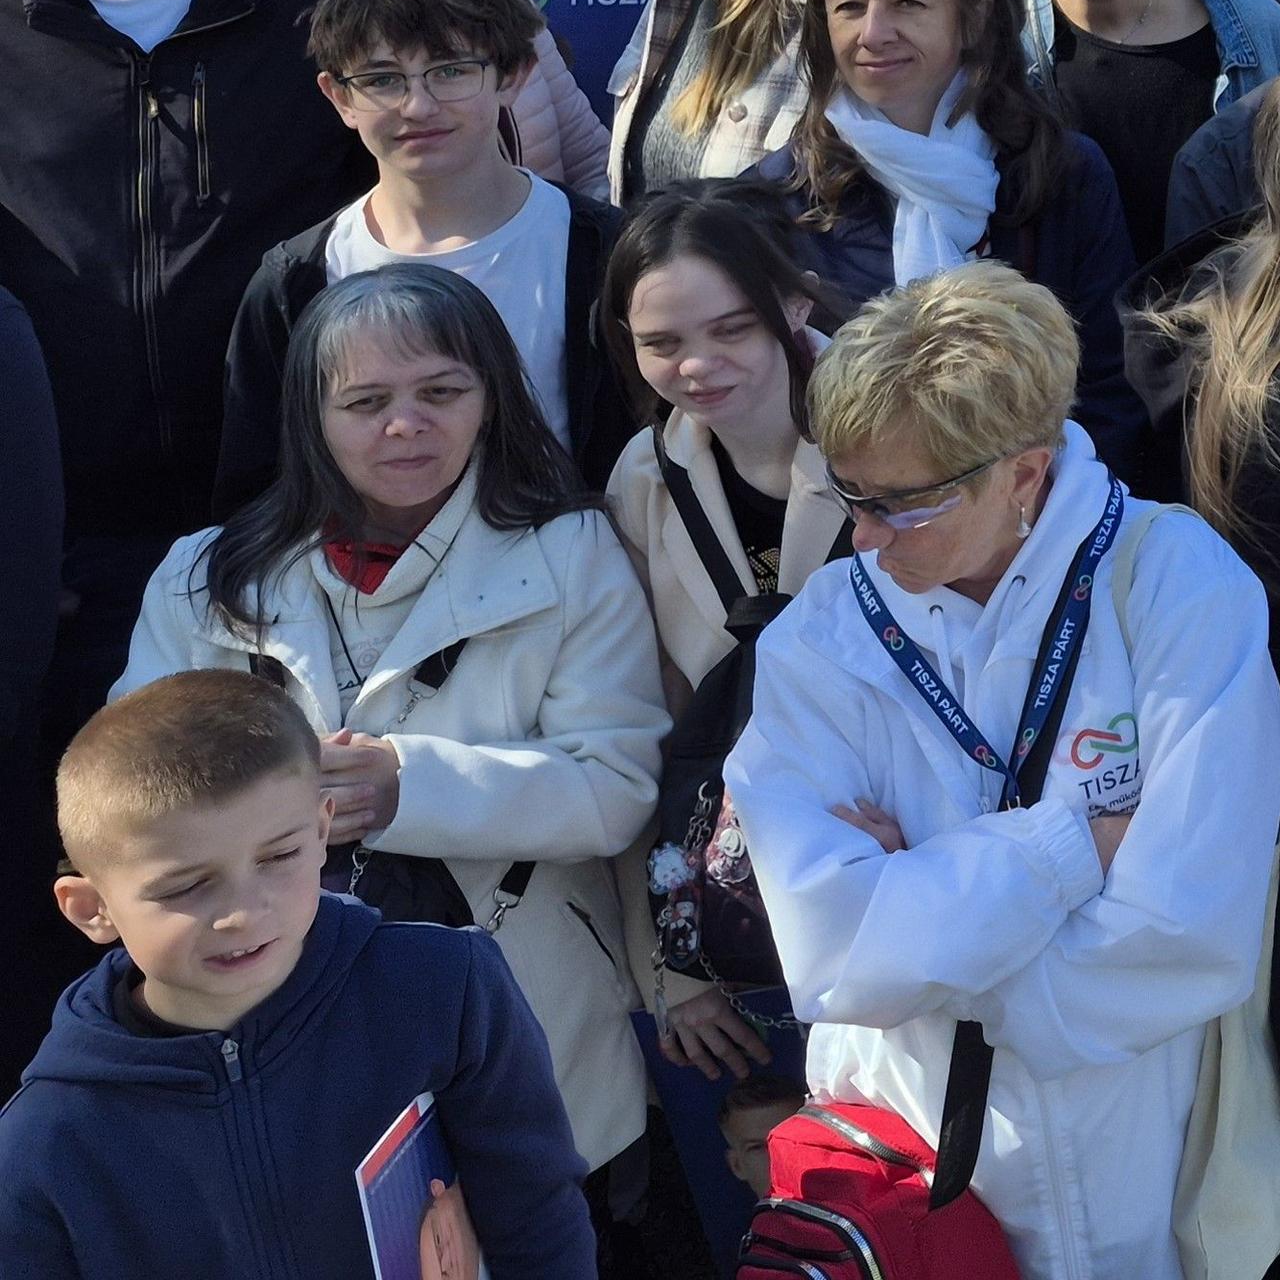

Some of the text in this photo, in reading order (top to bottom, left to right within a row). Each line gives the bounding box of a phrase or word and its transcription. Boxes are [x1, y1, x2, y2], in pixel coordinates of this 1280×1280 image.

[1090, 517, 1115, 558] TISZA
[859, 582, 881, 616] PÁRT
[1034, 618, 1076, 709] TISZA PÁRT
[910, 659, 969, 736] TISZA PÁRT
